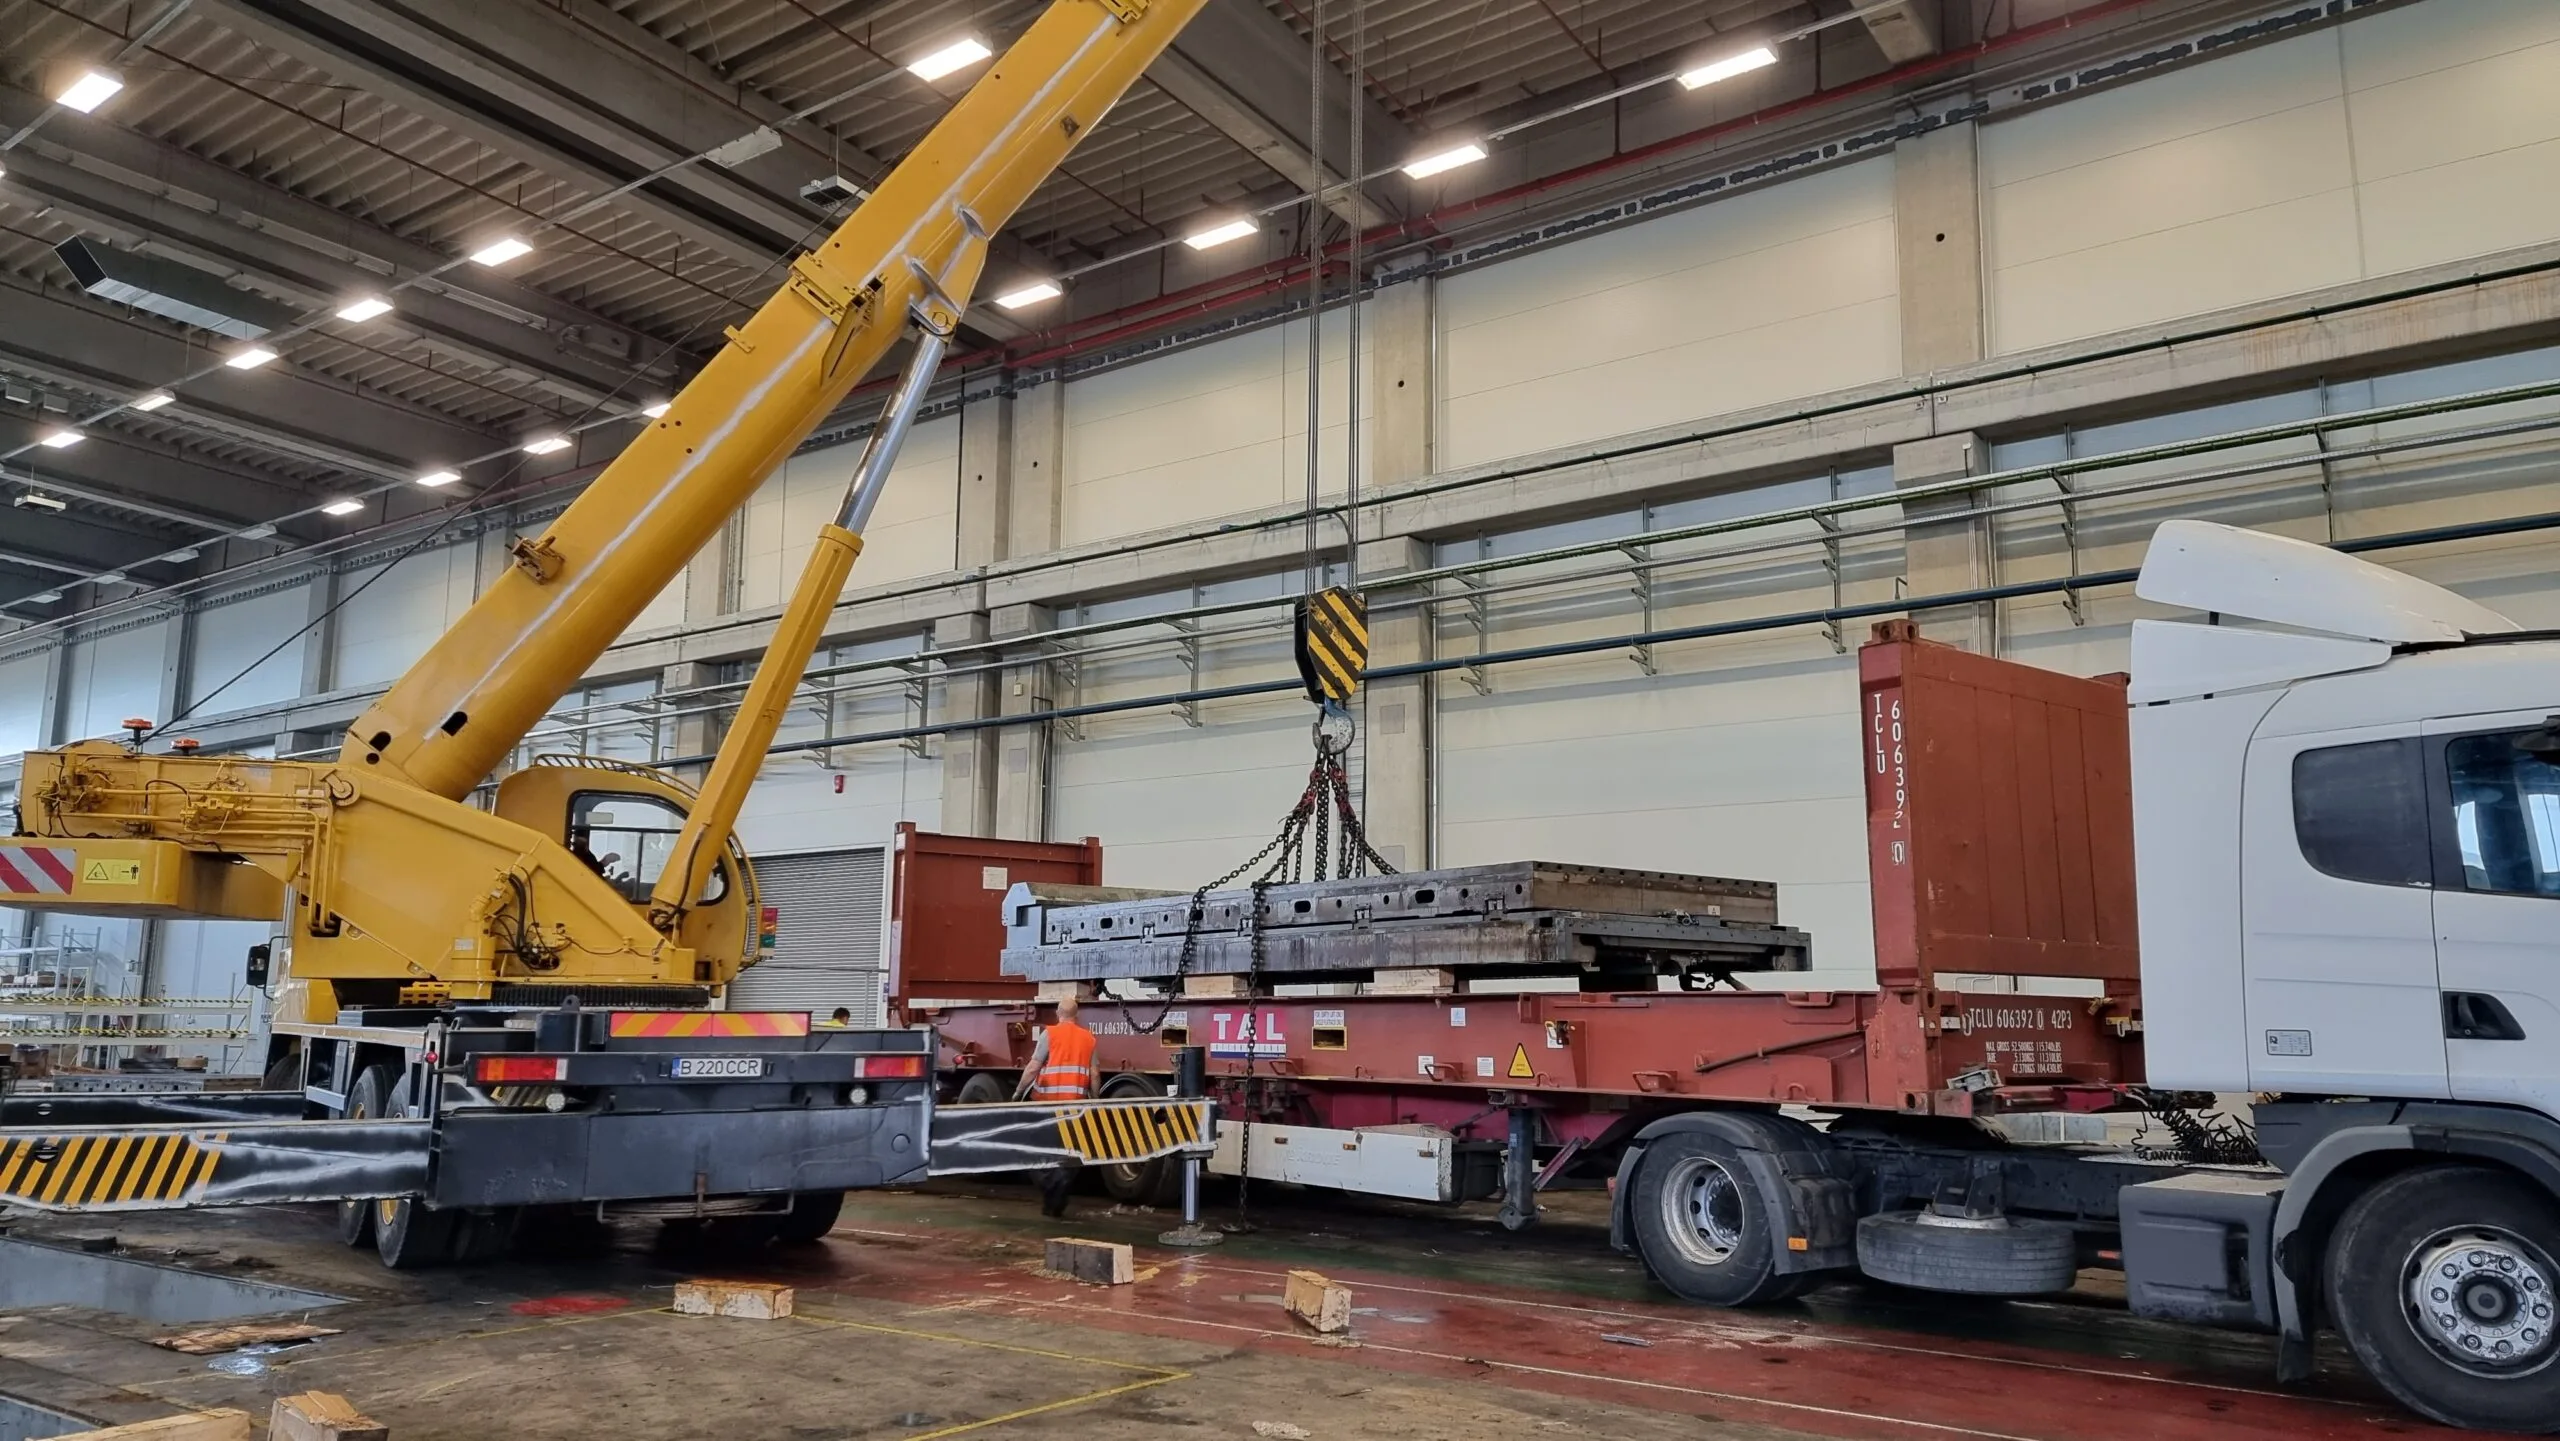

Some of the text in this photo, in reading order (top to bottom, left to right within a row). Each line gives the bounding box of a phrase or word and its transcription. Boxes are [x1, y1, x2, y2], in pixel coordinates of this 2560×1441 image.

[1874, 693, 1886, 774] TCLU
[1089, 1022, 1103, 1035] TCLU
[1105, 1022, 1128, 1035] 606392
[1213, 1013, 1284, 1041] TAL
[1969, 1008, 1993, 1028] TCLU
[1997, 1009, 2033, 1029] 606392
[2051, 1010, 2072, 1030] 42P3
[681, 1060, 759, 1075] B 220 CCR
